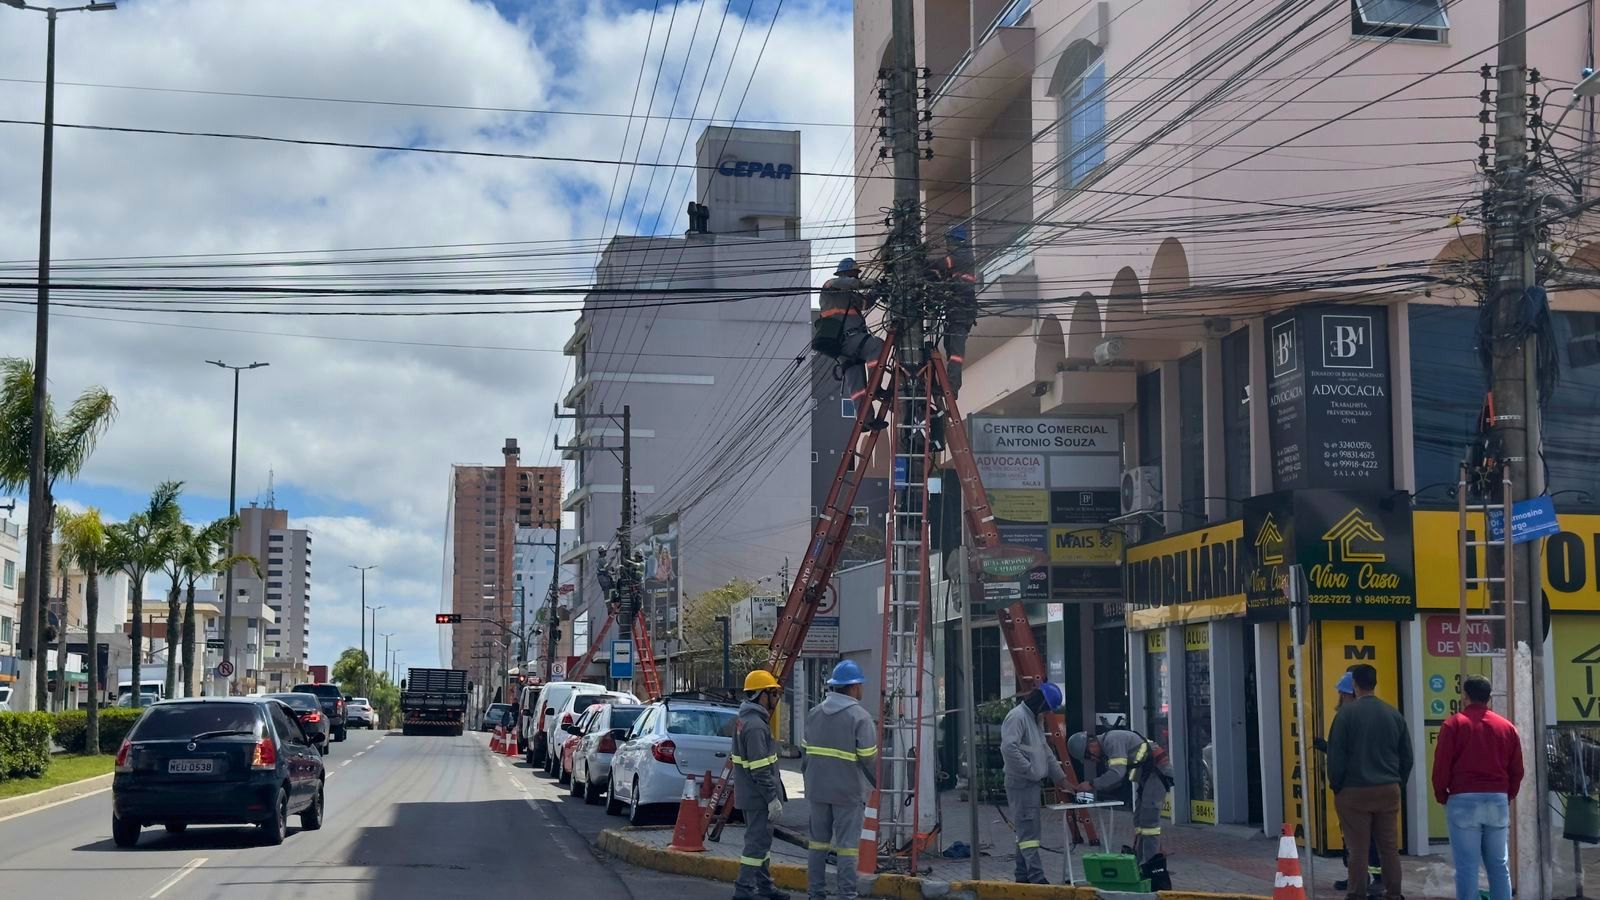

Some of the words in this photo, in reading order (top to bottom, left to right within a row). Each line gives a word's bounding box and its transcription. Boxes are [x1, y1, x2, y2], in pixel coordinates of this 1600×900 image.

[1312, 384, 1385, 397] ADVOCACIA
[983, 423, 1034, 435] CENTRO
[1037, 423, 1108, 435] COMERCIAL
[996, 436, 1051, 447] ANTONIO
[1054, 436, 1096, 447] SOUZA
[976, 456, 1041, 467] ADVOCACIA
[1492, 521, 1528, 536] Cargo
[1056, 534, 1095, 548] MAIS
[1309, 563, 1350, 589] Viva
[1358, 563, 1401, 590] Casa
[1308, 594, 1352, 605] 3222-7272
[1364, 594, 1412, 606] 98410-7272
[1437, 641, 1455, 653] DE
